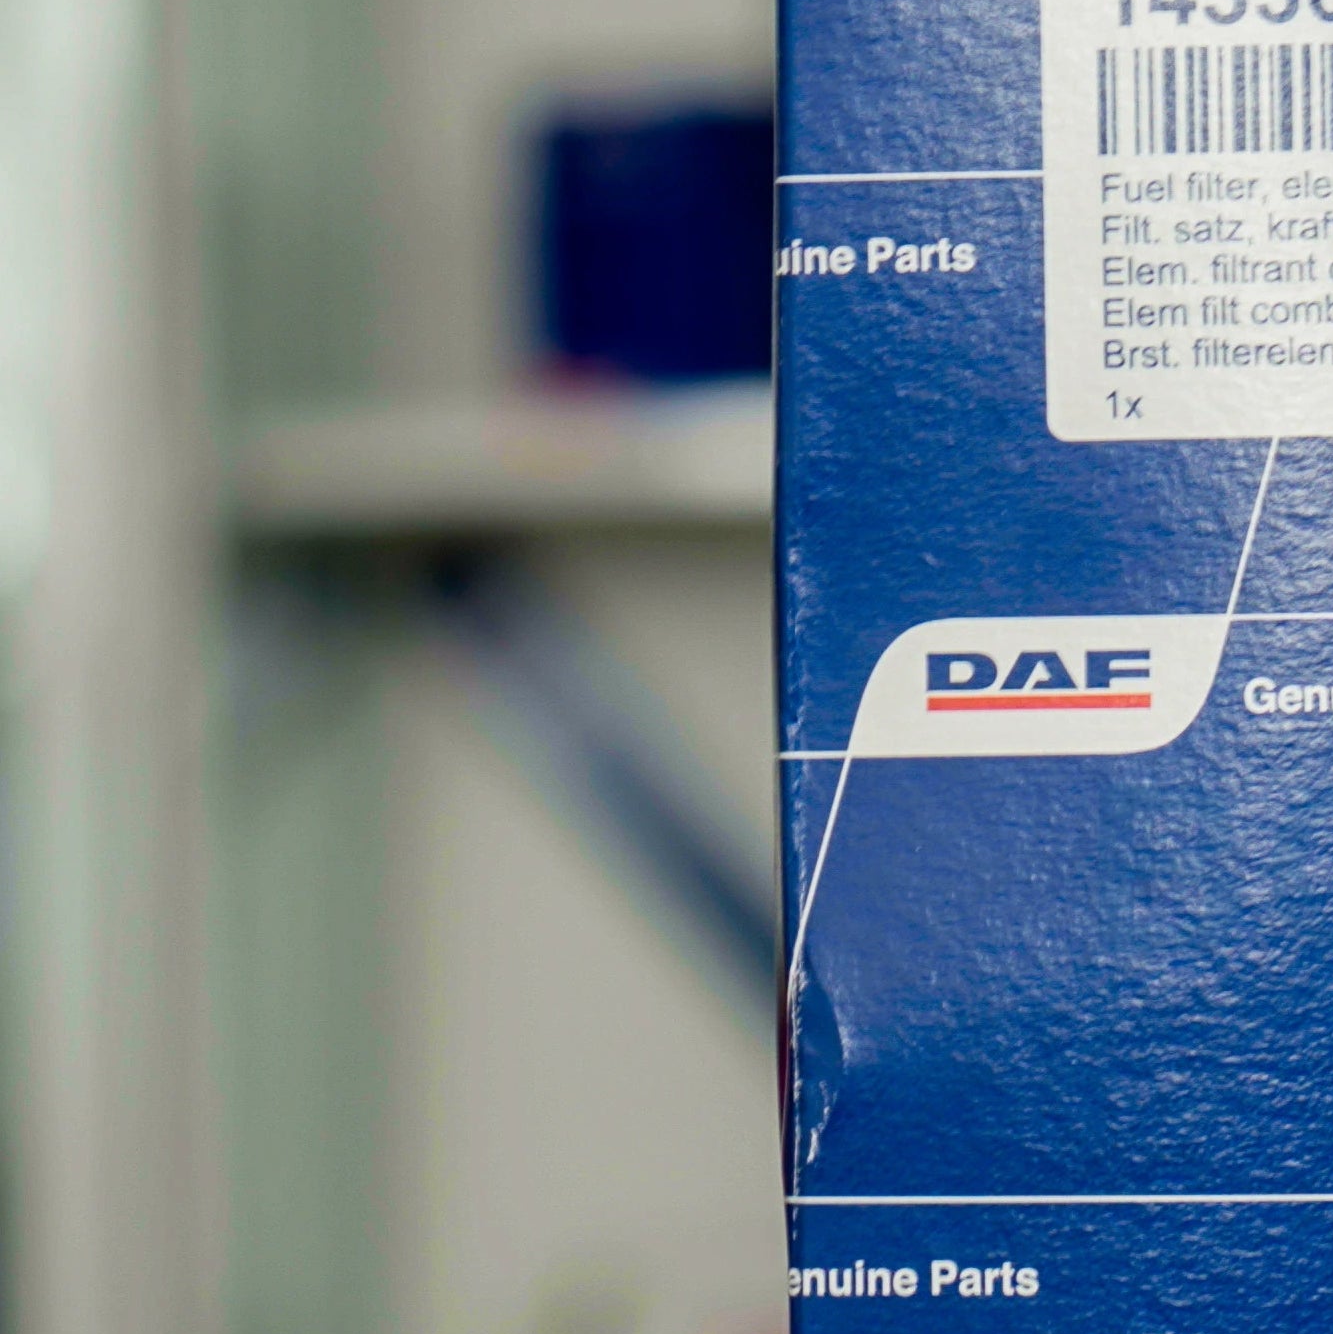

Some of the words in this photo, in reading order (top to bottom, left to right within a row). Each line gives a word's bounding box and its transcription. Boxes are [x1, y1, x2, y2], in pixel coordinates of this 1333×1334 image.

[1101, 174, 1175, 204] Fuel
[1187, 172, 1270, 204] filter,
[1102, 214, 1162, 245] Filt.
[1174, 215, 1257, 247] satz,
[867, 235, 977, 274] Parts
[1102, 255, 1199, 288] Elem.
[1210, 254, 1319, 285] filtrant
[1102, 297, 1189, 328] Elem
[1200, 295, 1242, 327] filt
[1103, 338, 1180, 369] Brst.
[1104, 390, 1144, 421] 1x
[926, 648, 1151, 691] DAF
[931, 1260, 1041, 1297] Parts
